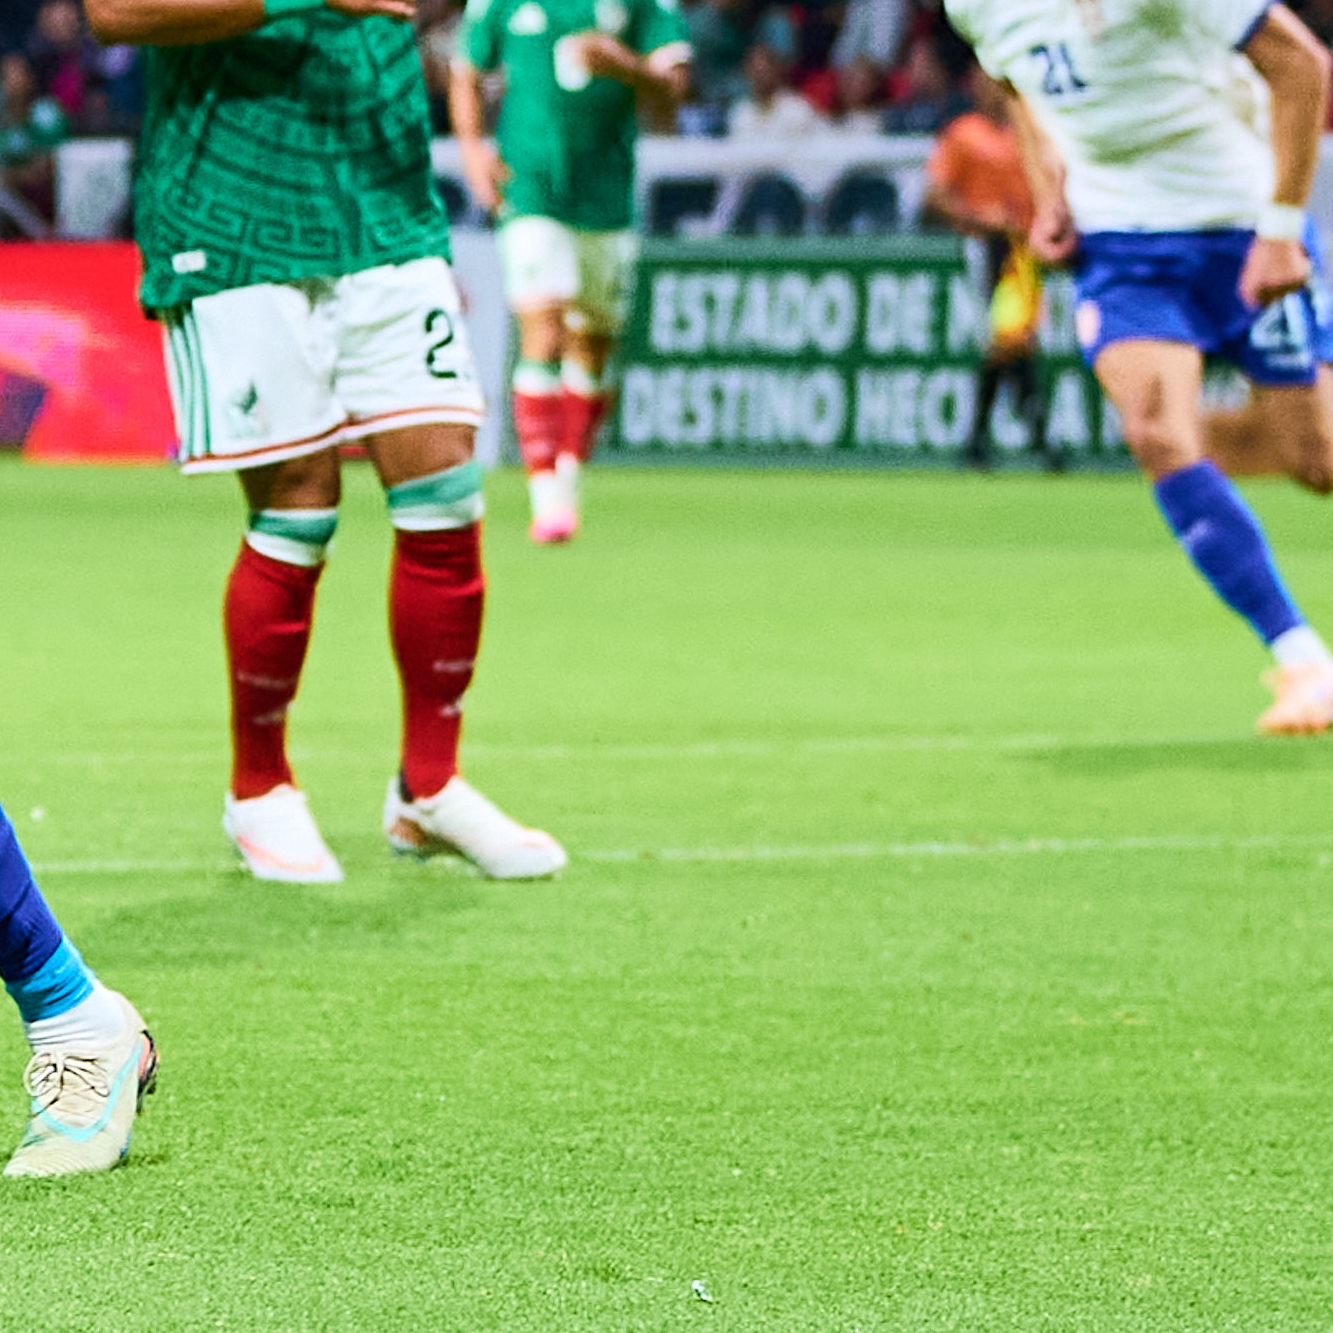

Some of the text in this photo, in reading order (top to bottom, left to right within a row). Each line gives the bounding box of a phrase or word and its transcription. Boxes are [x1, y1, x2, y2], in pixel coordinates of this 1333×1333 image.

[1030, 43, 1087, 95] 21
[650, 270, 856, 354] ESTADO
[865, 271, 932, 355] DE
[622, 366, 844, 447] DESTINO
